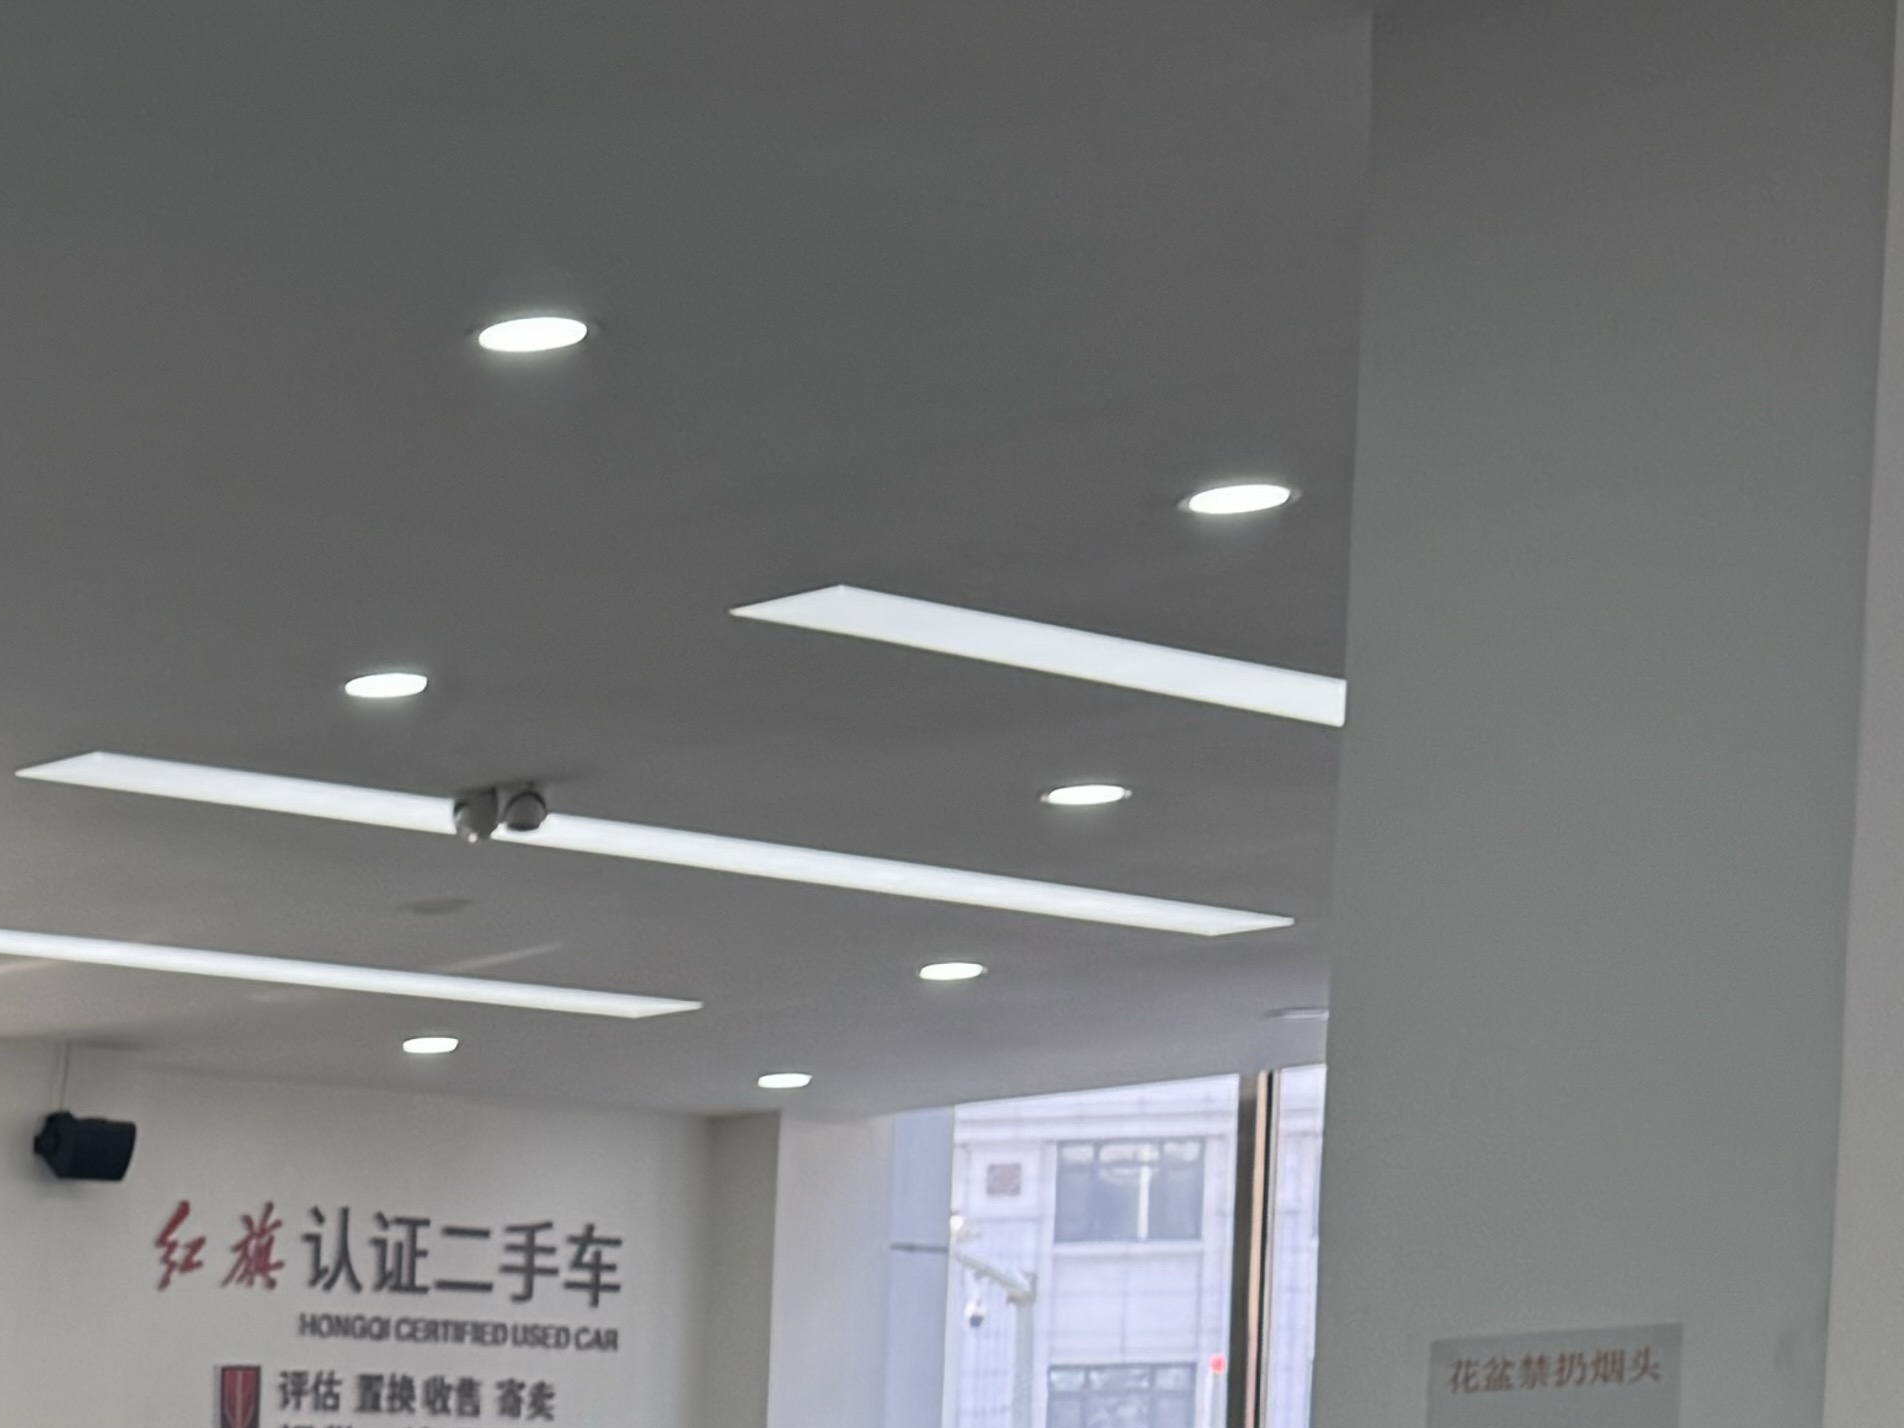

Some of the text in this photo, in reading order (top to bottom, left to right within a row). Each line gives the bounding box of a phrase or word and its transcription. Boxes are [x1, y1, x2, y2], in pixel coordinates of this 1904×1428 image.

[298, 1313, 619, 1351] HONGQI CERTIFIED USED CAR
[1449, 1346, 1662, 1394] 花盆禁扔烟头
[279, 1371, 555, 1421] 评估 置换 收售 寄卖
